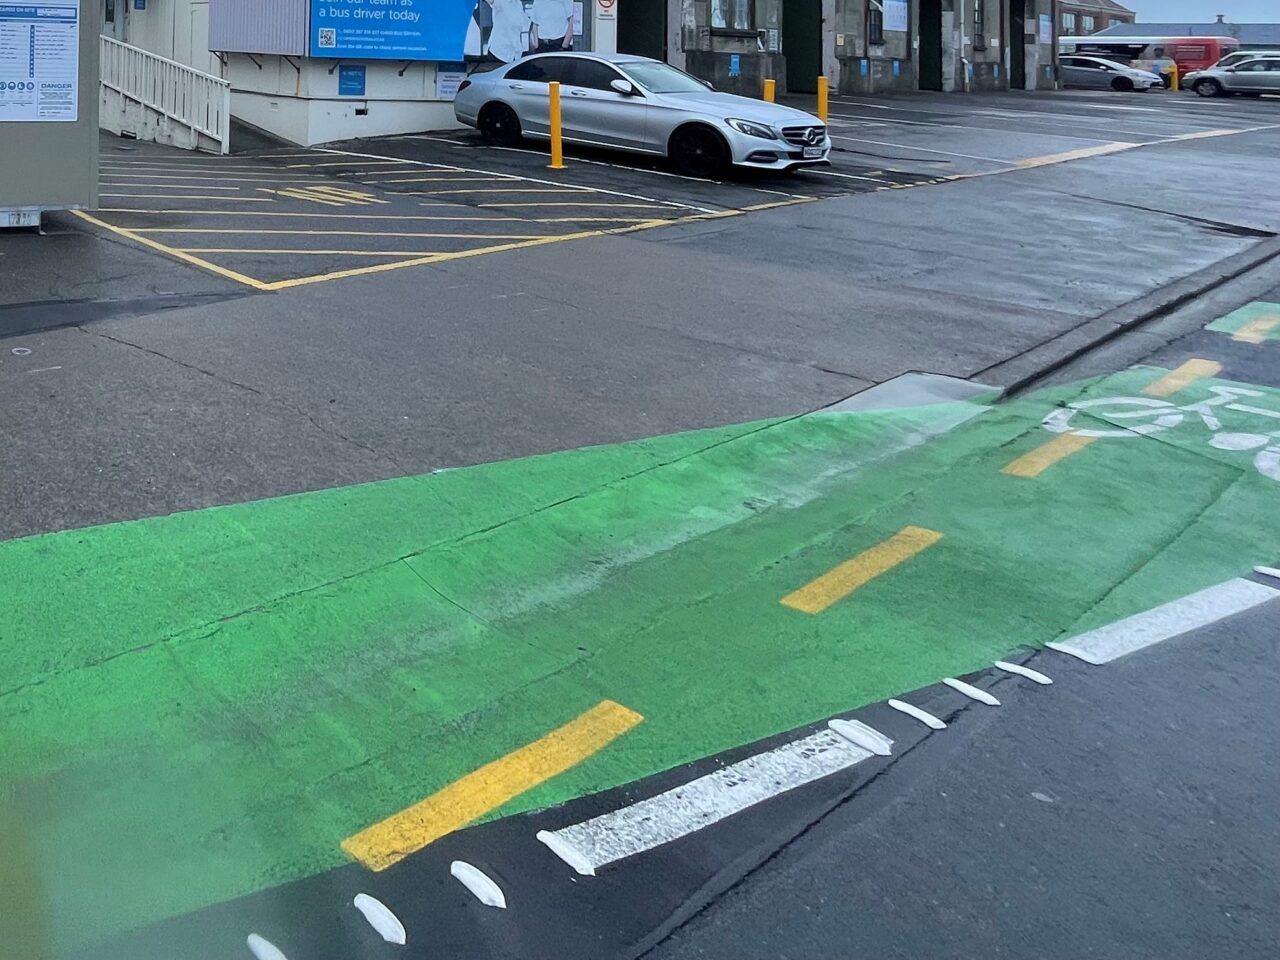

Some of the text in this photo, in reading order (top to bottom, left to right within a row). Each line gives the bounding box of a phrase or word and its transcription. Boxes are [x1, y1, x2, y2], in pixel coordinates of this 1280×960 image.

[318, 6, 421, 23] a bus driver today
